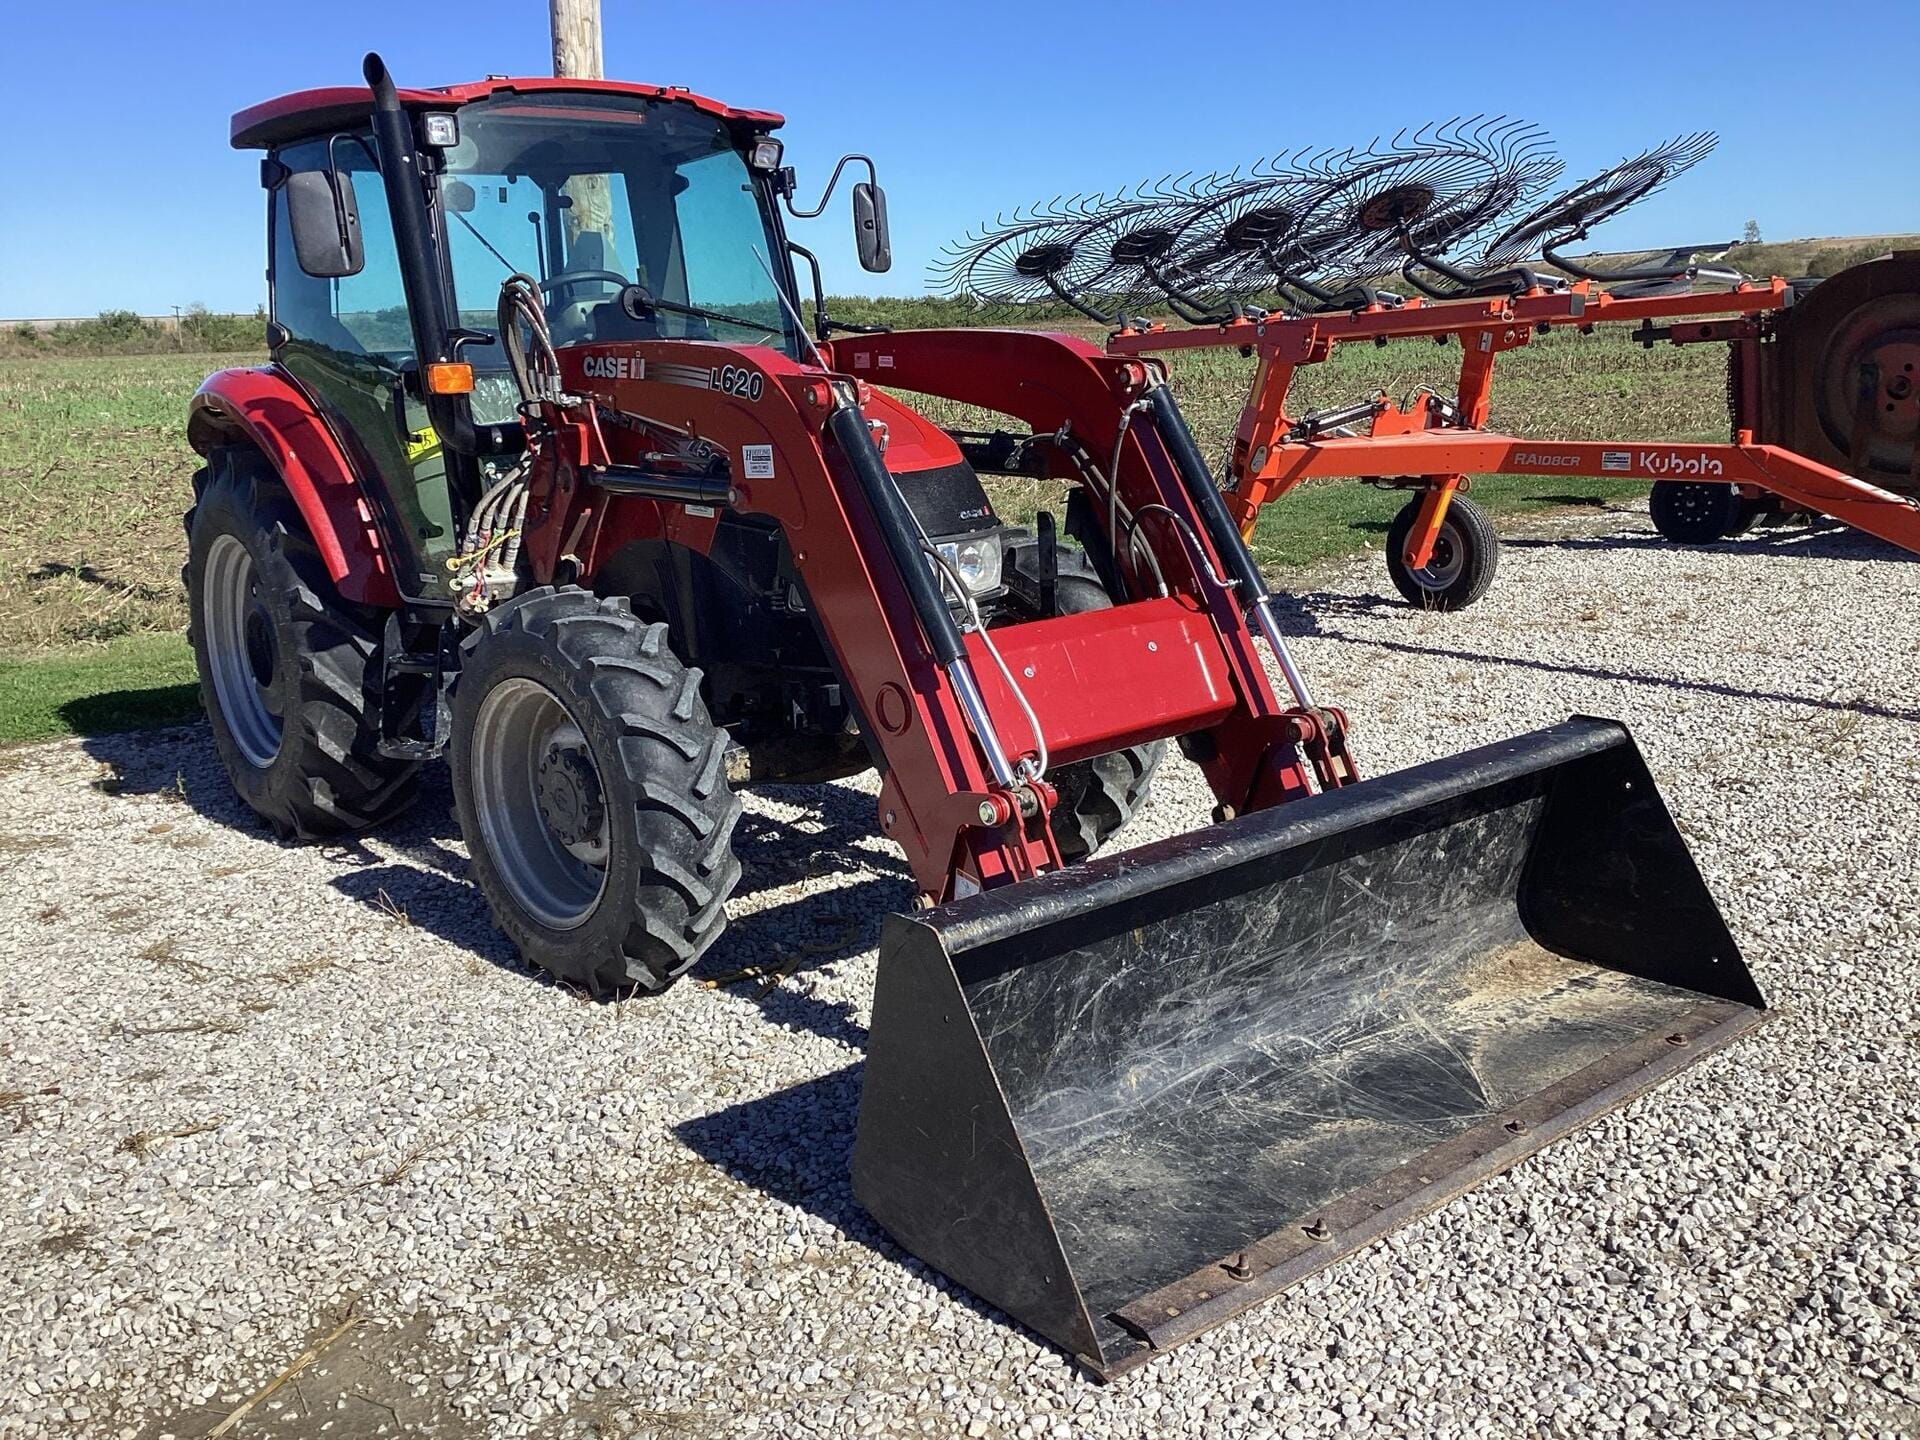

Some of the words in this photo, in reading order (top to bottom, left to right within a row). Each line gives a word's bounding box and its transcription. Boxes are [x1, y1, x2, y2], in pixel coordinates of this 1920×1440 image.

[583, 356, 628, 378] CASE
[710, 364, 764, 402] L620
[1514, 453, 1581, 466] RA108CR
[1640, 452, 1723, 475] Kubota
